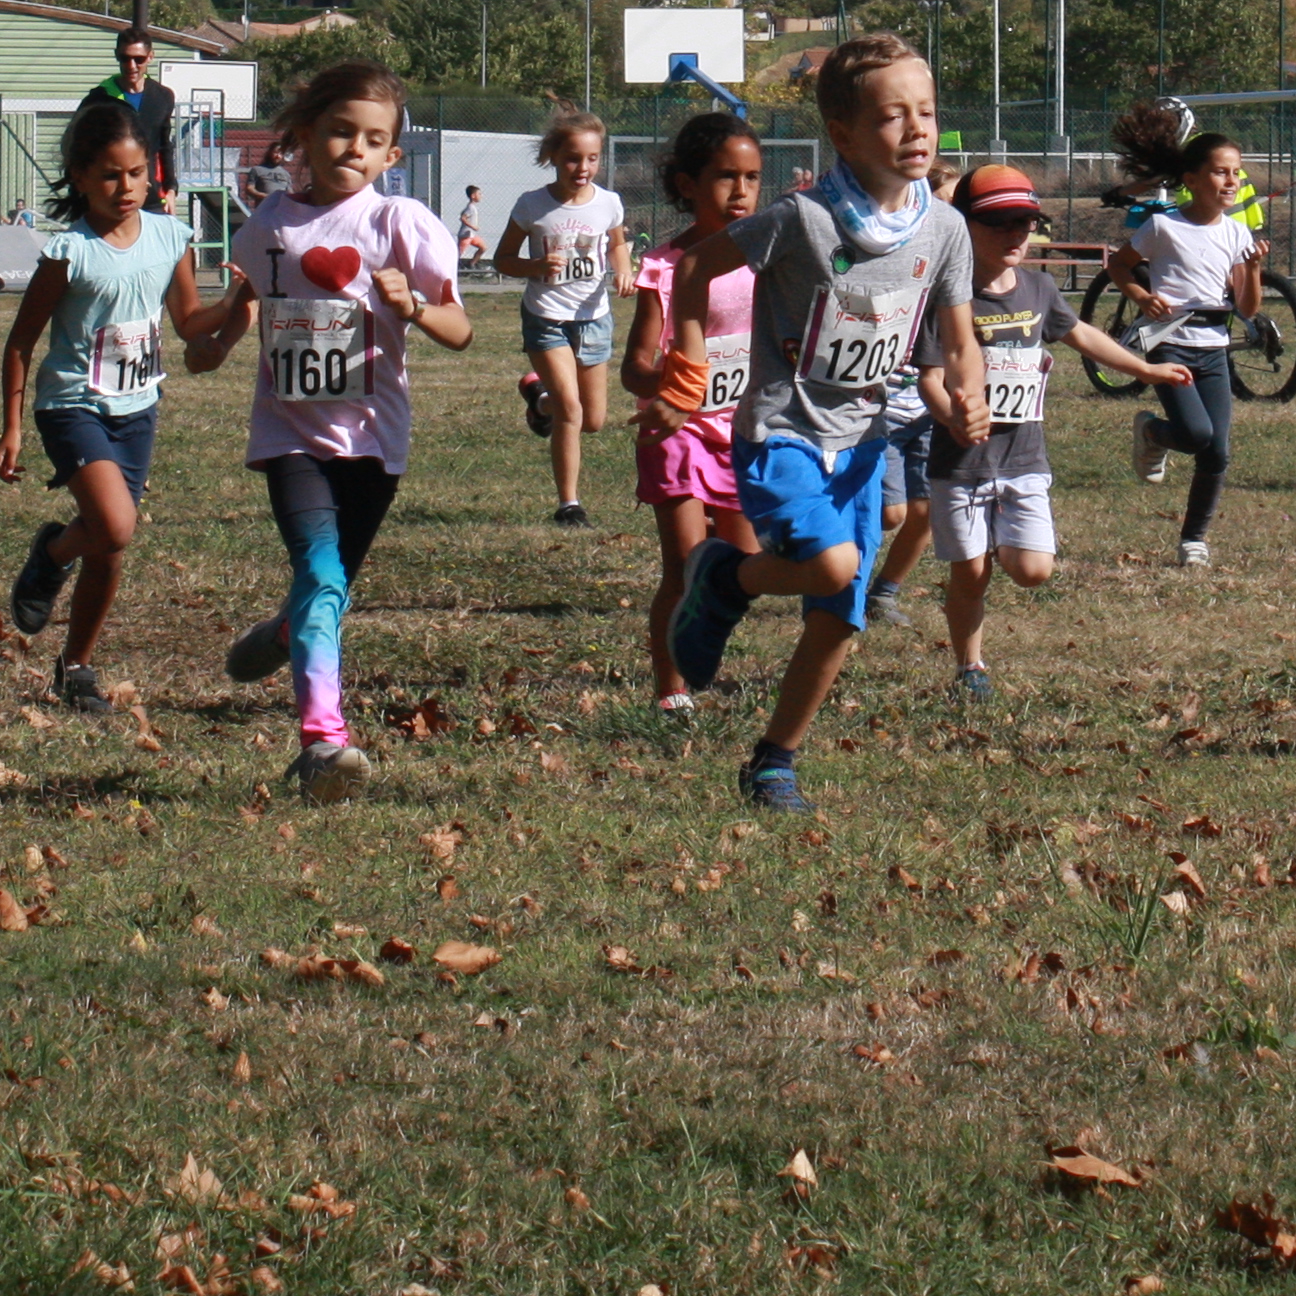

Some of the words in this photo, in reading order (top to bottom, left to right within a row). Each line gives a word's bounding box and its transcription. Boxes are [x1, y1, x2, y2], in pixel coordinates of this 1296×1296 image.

[550, 217, 594, 235] Hilfiger
[265, 247, 288, 298] I
[974, 315, 1002, 325] GOOD
[1003, 310, 1034, 323] PLAYER
[116, 350, 155, 391] 1161
[270, 347, 347, 396] 1160
[825, 333, 900, 382] 1203
